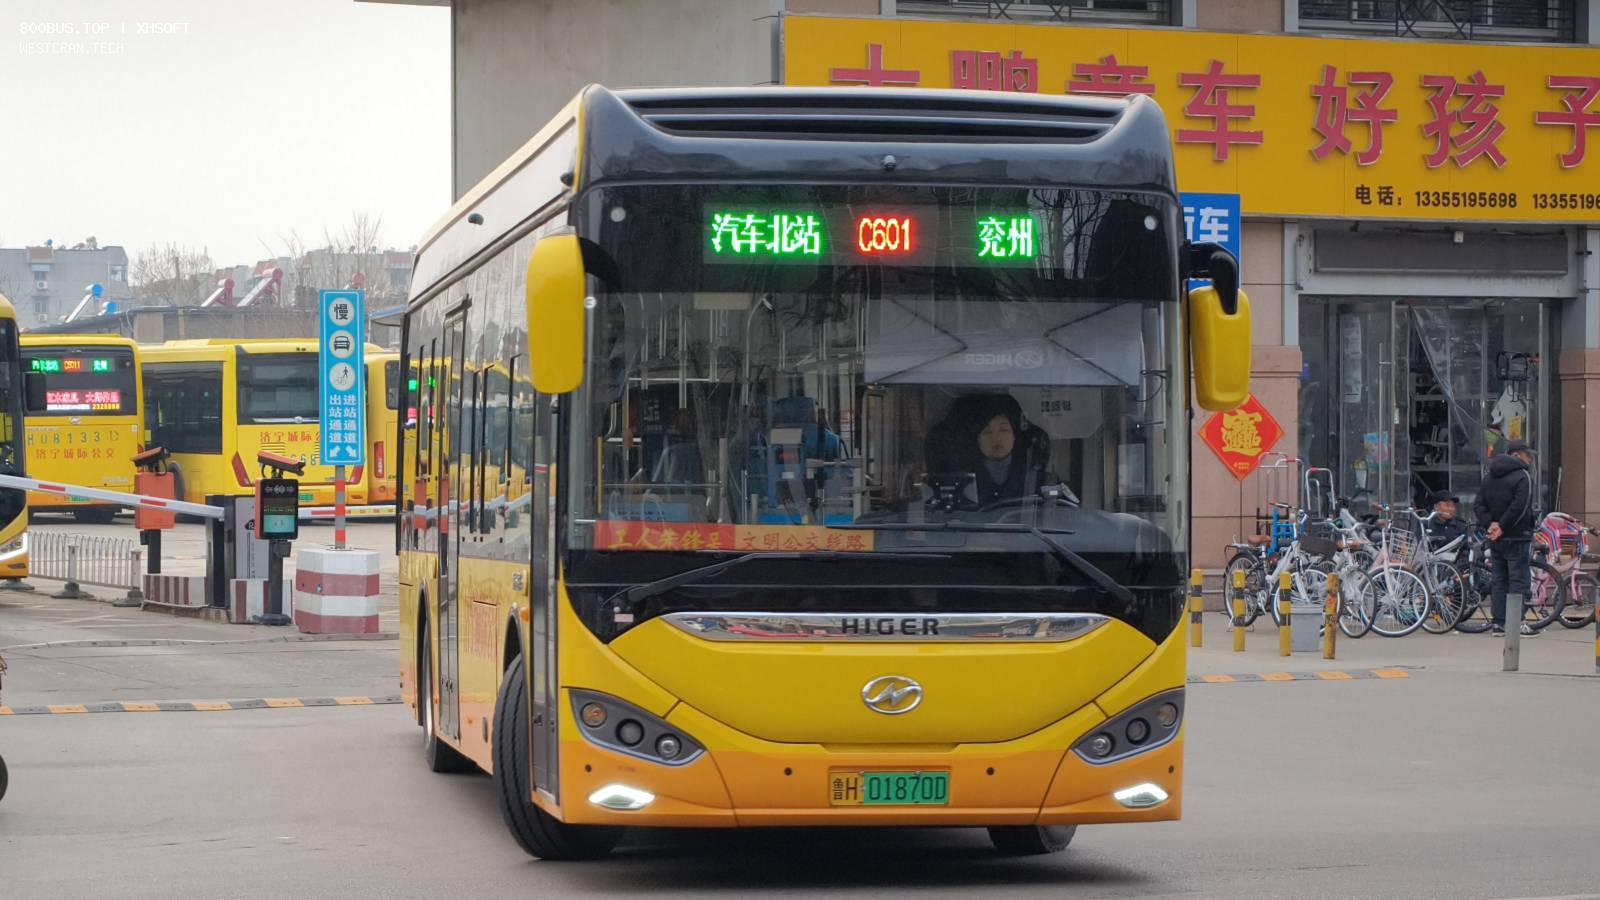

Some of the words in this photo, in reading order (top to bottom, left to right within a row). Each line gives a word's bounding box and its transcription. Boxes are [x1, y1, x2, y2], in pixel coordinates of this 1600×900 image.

[1415, 190, 1518, 208] 13355195698
[712, 213, 821, 254] 汽车北站
[858, 217, 911, 252] C601
[978, 216, 1033, 257] 兖州
[334, 303, 349, 320] 慢
[841, 618, 940, 635] HIGER
[832, 777, 858, 801] 鲁H
[868, 776, 947, 801] 01870D
